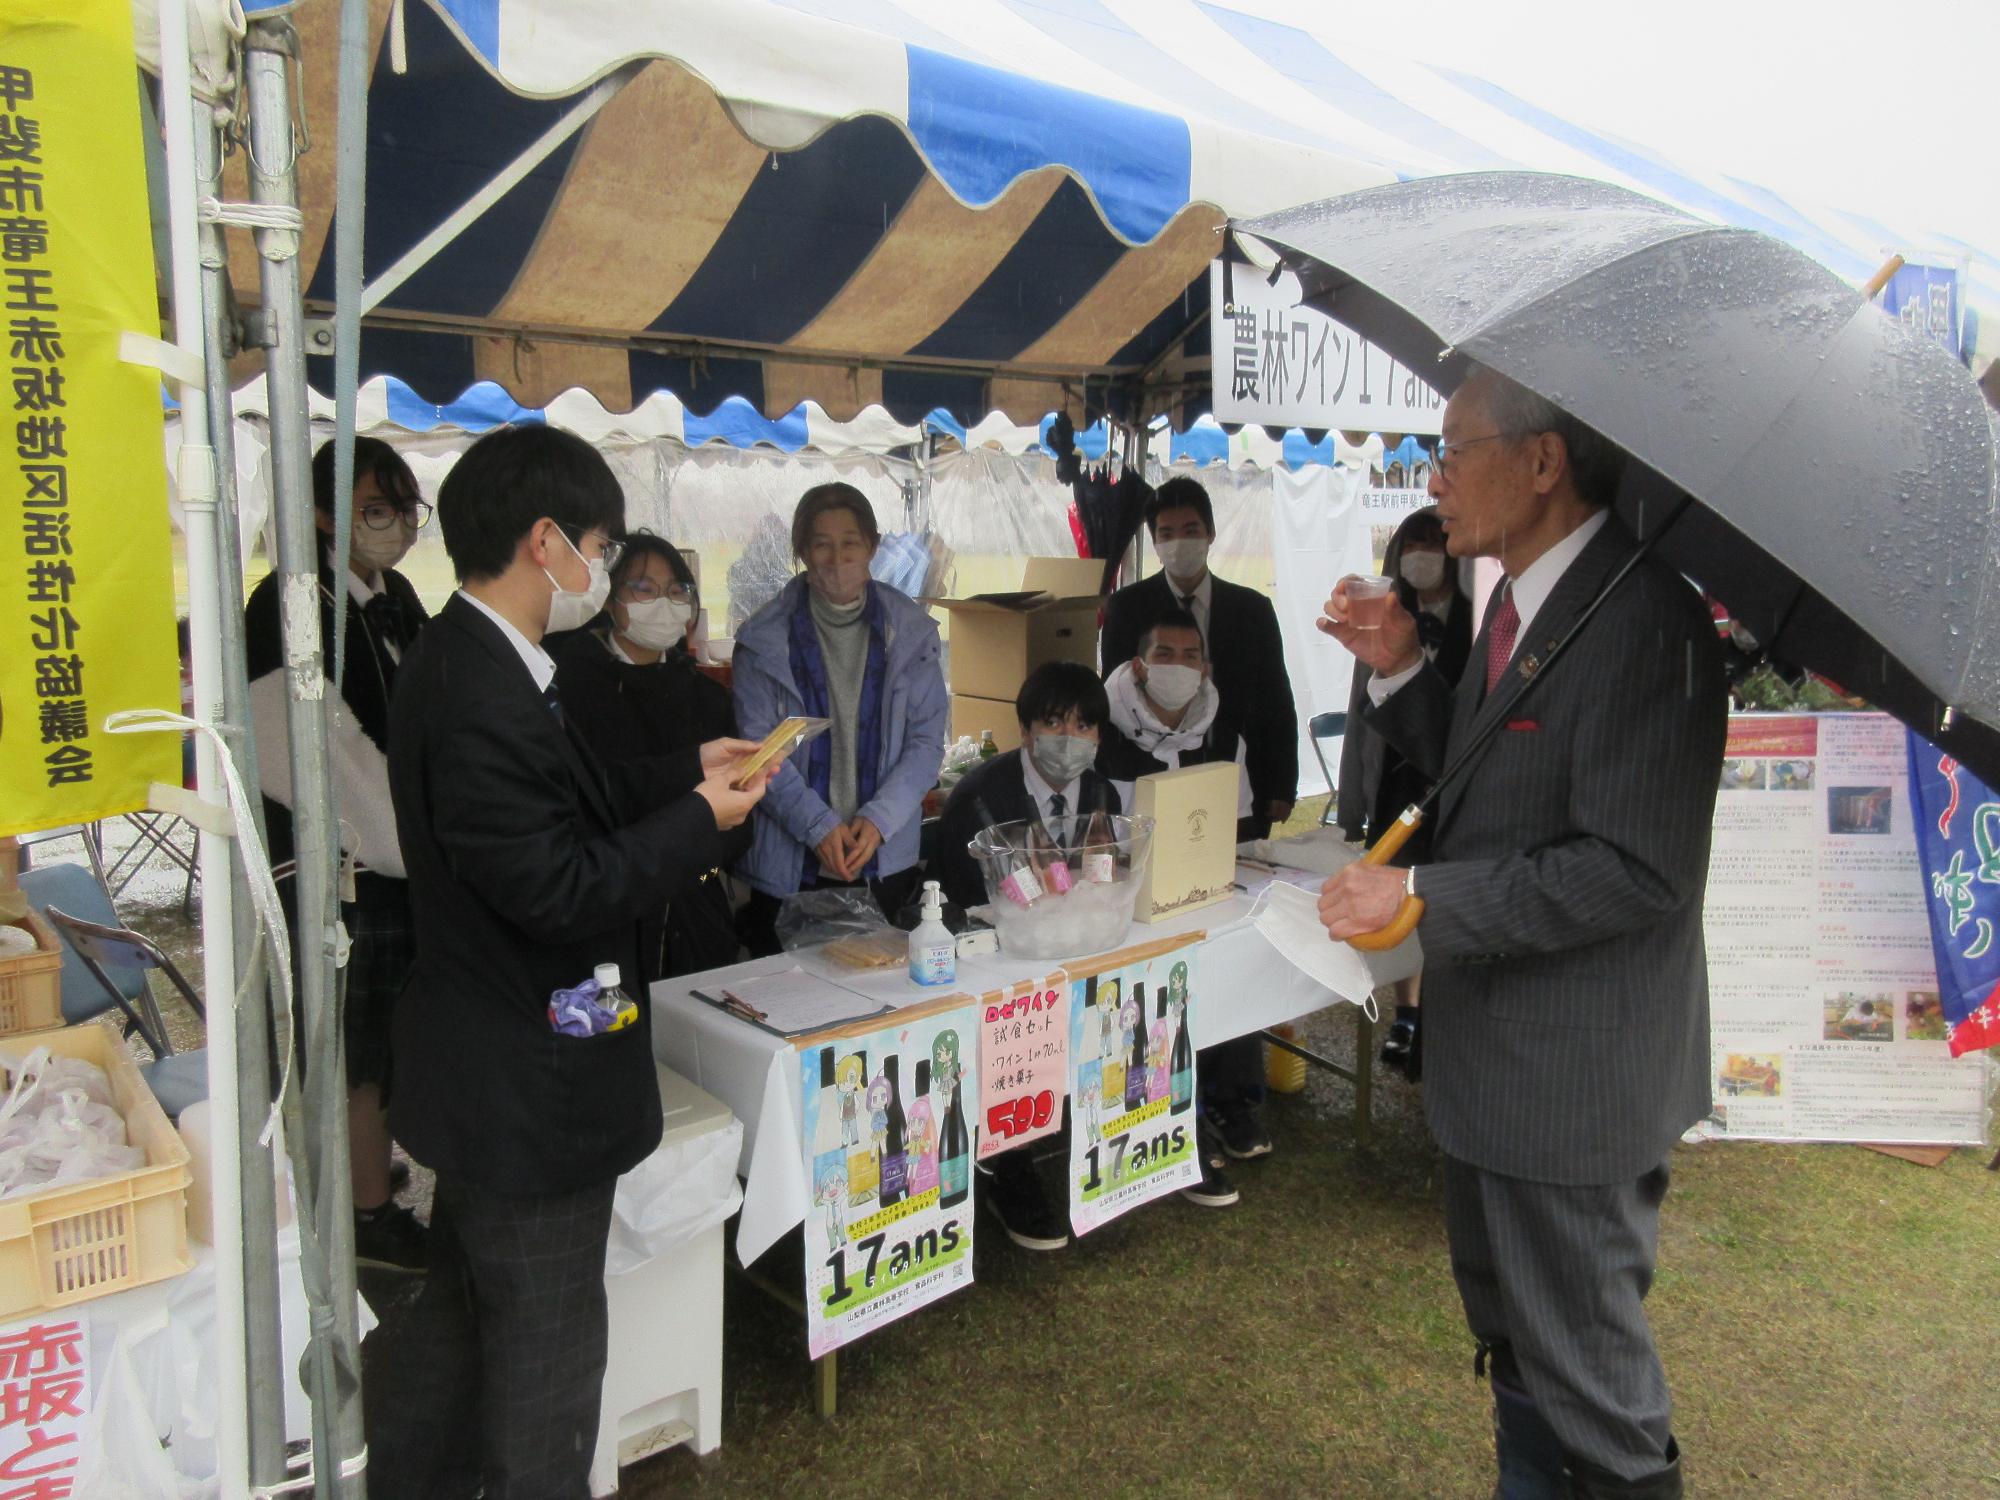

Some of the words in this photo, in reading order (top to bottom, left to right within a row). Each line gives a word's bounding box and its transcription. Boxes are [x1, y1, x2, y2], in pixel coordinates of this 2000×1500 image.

[985, 990, 1060, 1024] ロゼワイン
[993, 1015, 1053, 1046] 試食セット
[987, 1090, 1055, 1140] 500
[1084, 1126, 1186, 1192] 17ans
[826, 1220, 960, 1306] 17ans
